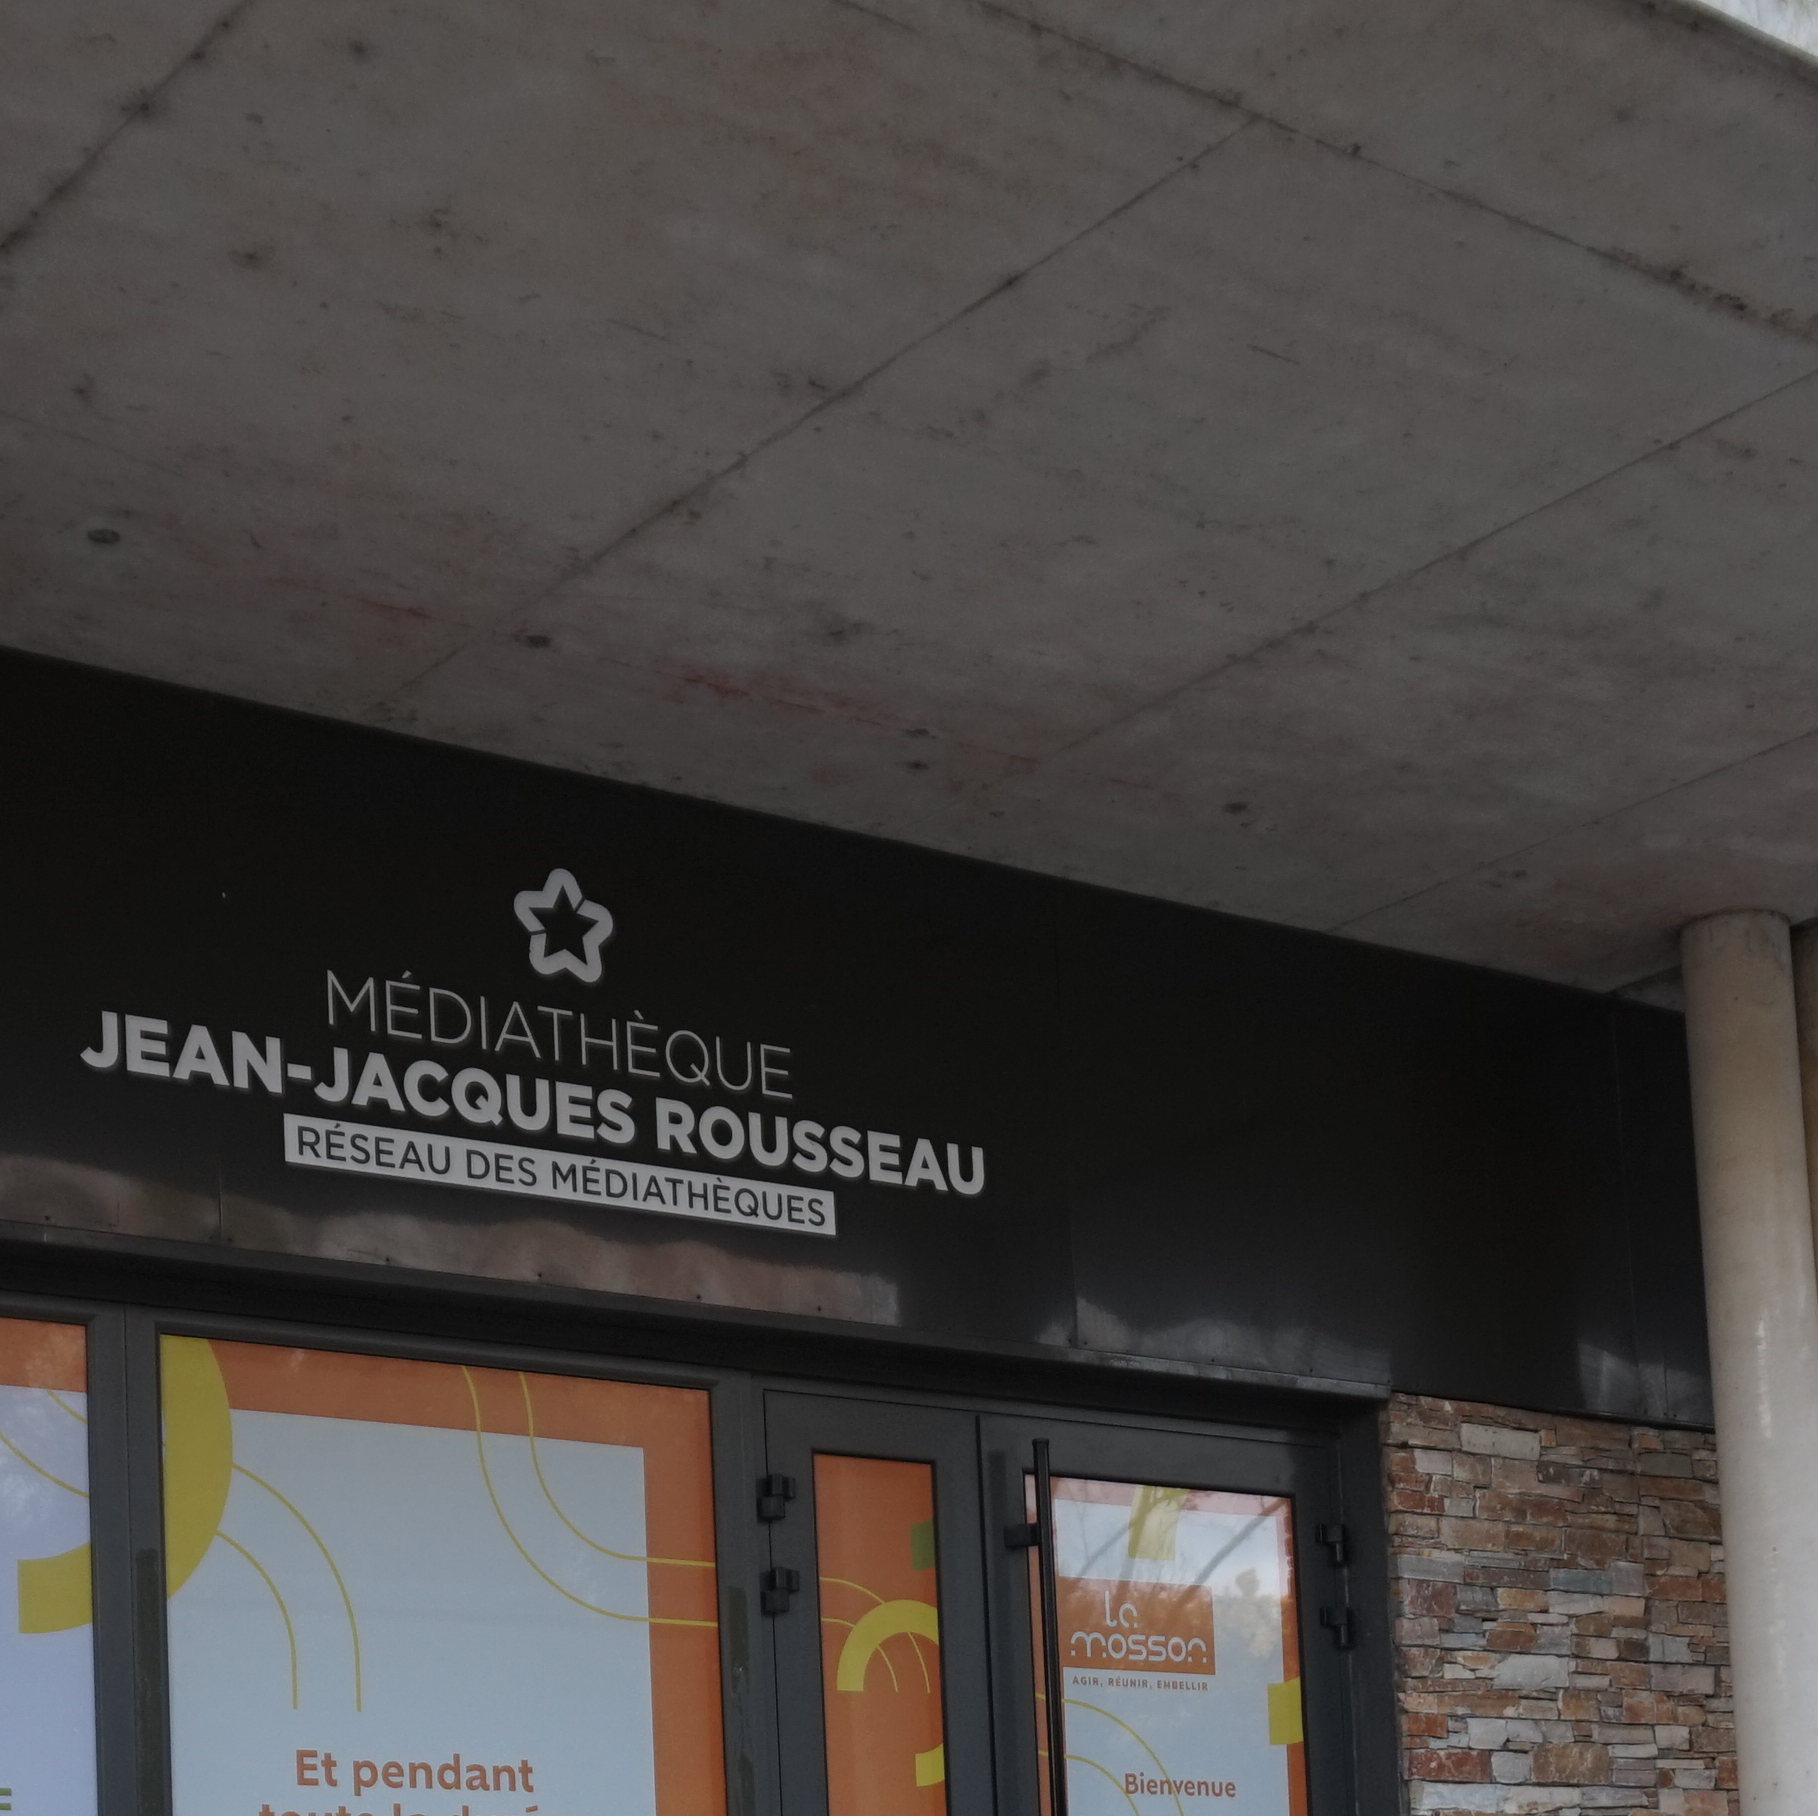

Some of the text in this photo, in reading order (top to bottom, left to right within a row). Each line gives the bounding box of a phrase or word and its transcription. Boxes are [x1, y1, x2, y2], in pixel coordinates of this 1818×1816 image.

[325, 966, 794, 1100] MÉDIATHÈQUE
[79, 1009, 987, 1196] JEAN-JACQUES ROUSSEAU
[296, 1119, 828, 1230] RÉSEAU DES MÉDIATHÈQUES
[1105, 1590, 1138, 1628] la
[1072, 1675, 1208, 1691] AGIR, RÉUNIR, EMBELLIR
[295, 1749, 534, 1797] Et pendant
[1124, 1772, 1236, 1797] Bienvenue
